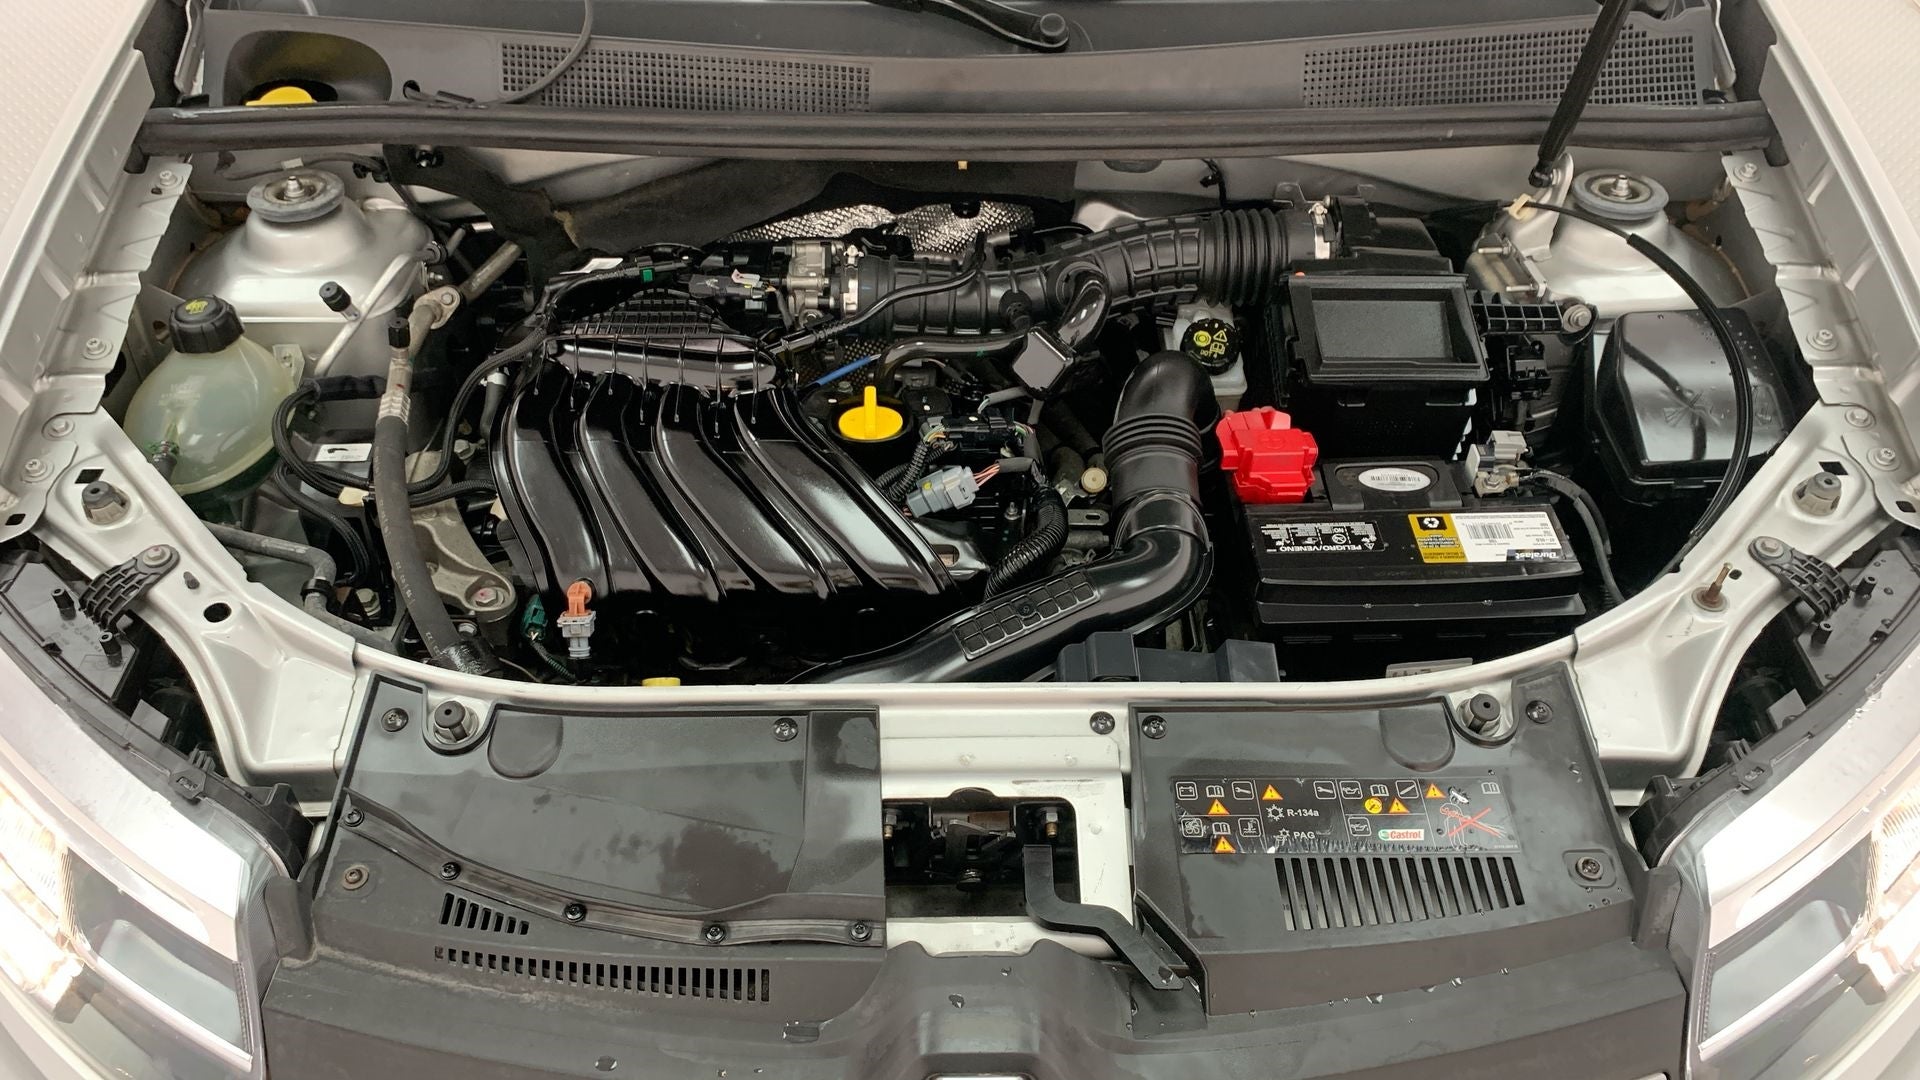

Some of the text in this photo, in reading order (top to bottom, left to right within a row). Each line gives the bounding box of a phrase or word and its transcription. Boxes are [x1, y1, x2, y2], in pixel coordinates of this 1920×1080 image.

[1279, 544, 1363, 552] PELIGRO/VENENO
[1515, 552, 1558, 560] Duralast
[1286, 808, 1320, 817] R-134a
[1293, 831, 1316, 840] PAG
[1390, 830, 1422, 839] Castrol
